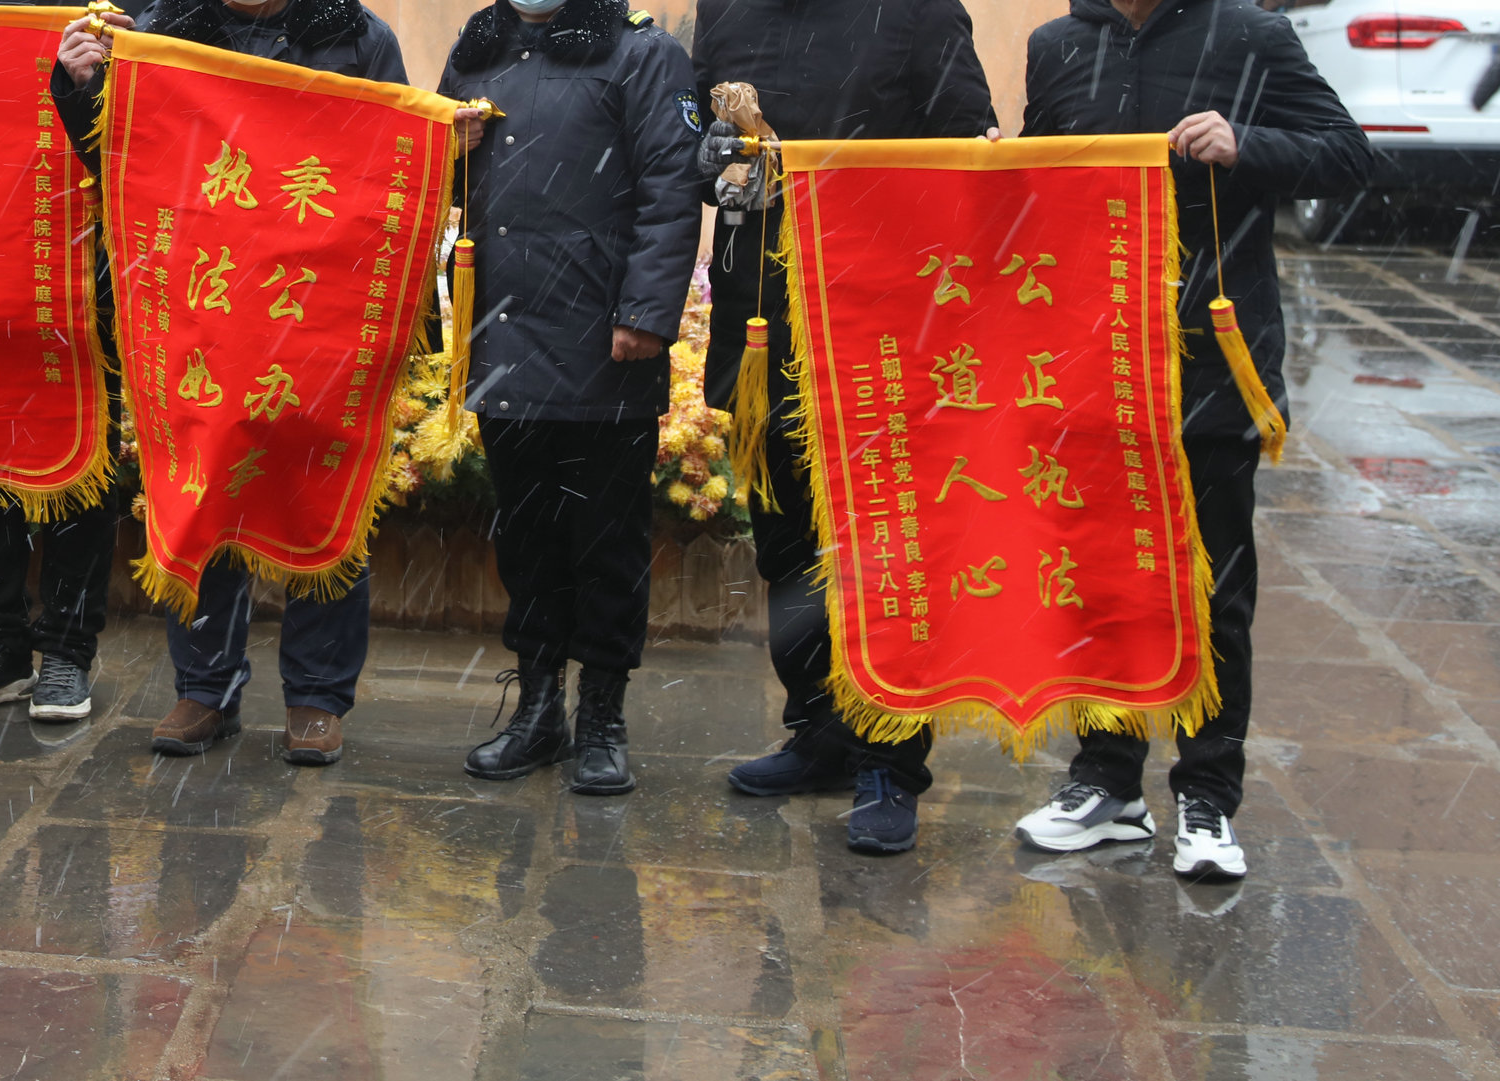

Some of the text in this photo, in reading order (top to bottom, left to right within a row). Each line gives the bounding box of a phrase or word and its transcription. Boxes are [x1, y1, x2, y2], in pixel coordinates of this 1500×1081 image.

[154, 207, 175, 255] 张涛
[178, 140, 258, 507] 执法如山
[224, 155, 337, 498] 秉公办事
[879, 334, 906, 406] 白朝华
[888, 412, 913, 484] 梁红党
[916, 254, 1007, 601] 公道人心
[999, 253, 1085, 609] 公正执法
[897, 490, 924, 564] 郭春良
